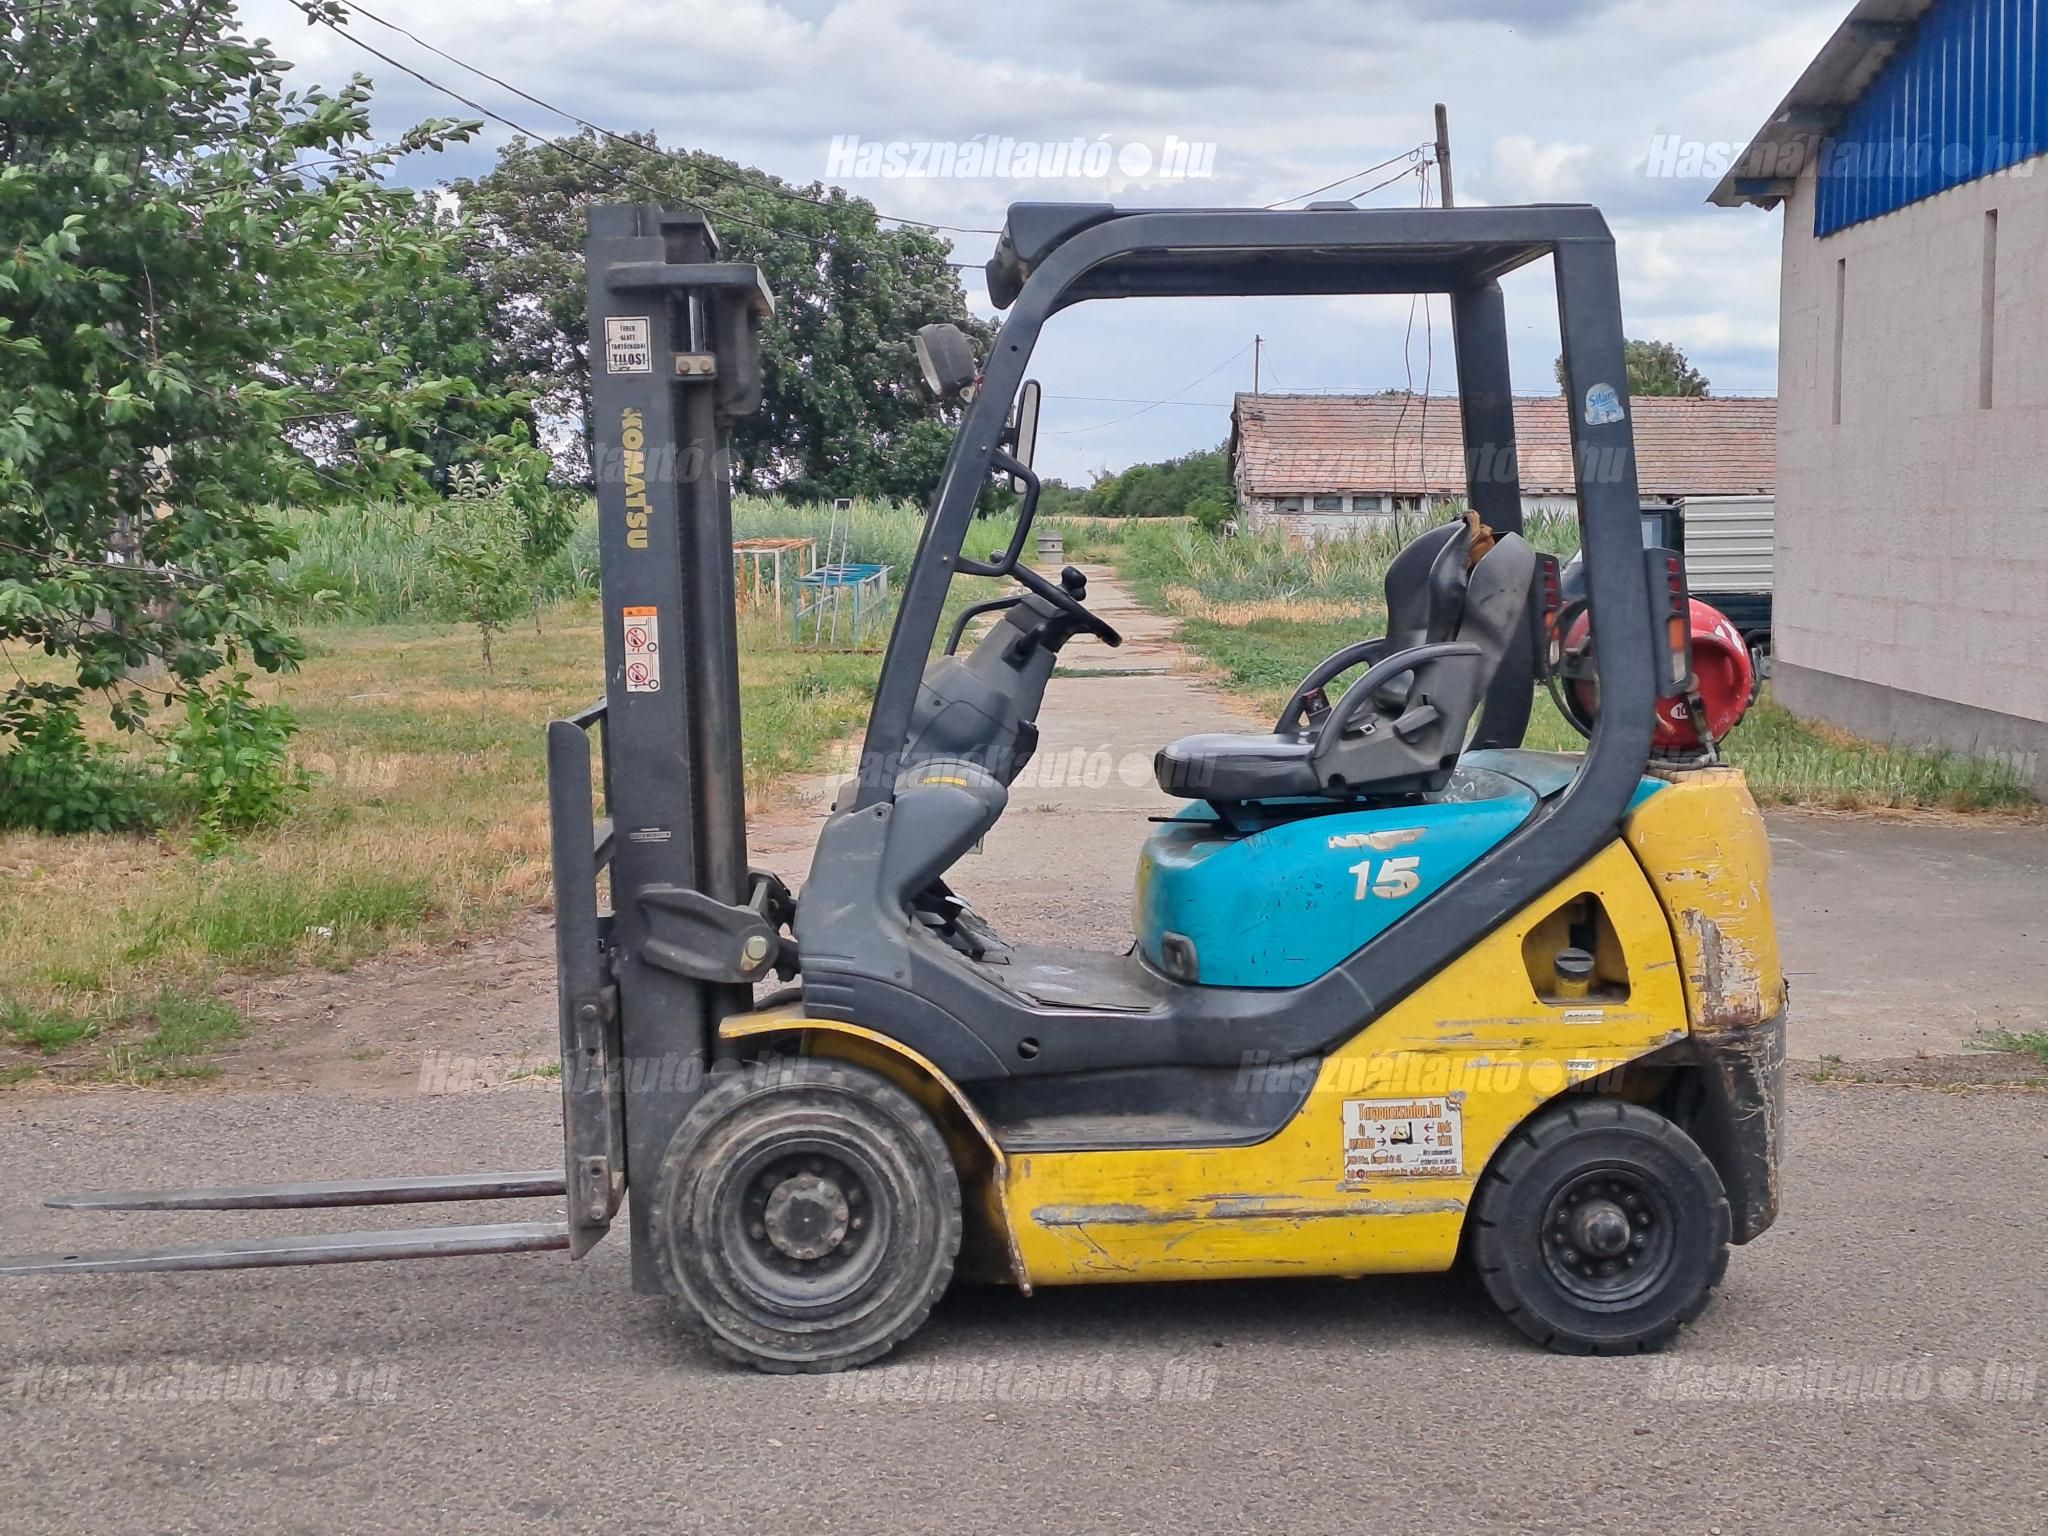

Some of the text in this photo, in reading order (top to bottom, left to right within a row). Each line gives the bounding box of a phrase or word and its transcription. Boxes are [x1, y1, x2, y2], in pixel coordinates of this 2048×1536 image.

[612, 353, 646, 366] TILOS!
[622, 407, 653, 549] KOMATSU
[1348, 855, 1420, 901] 15
